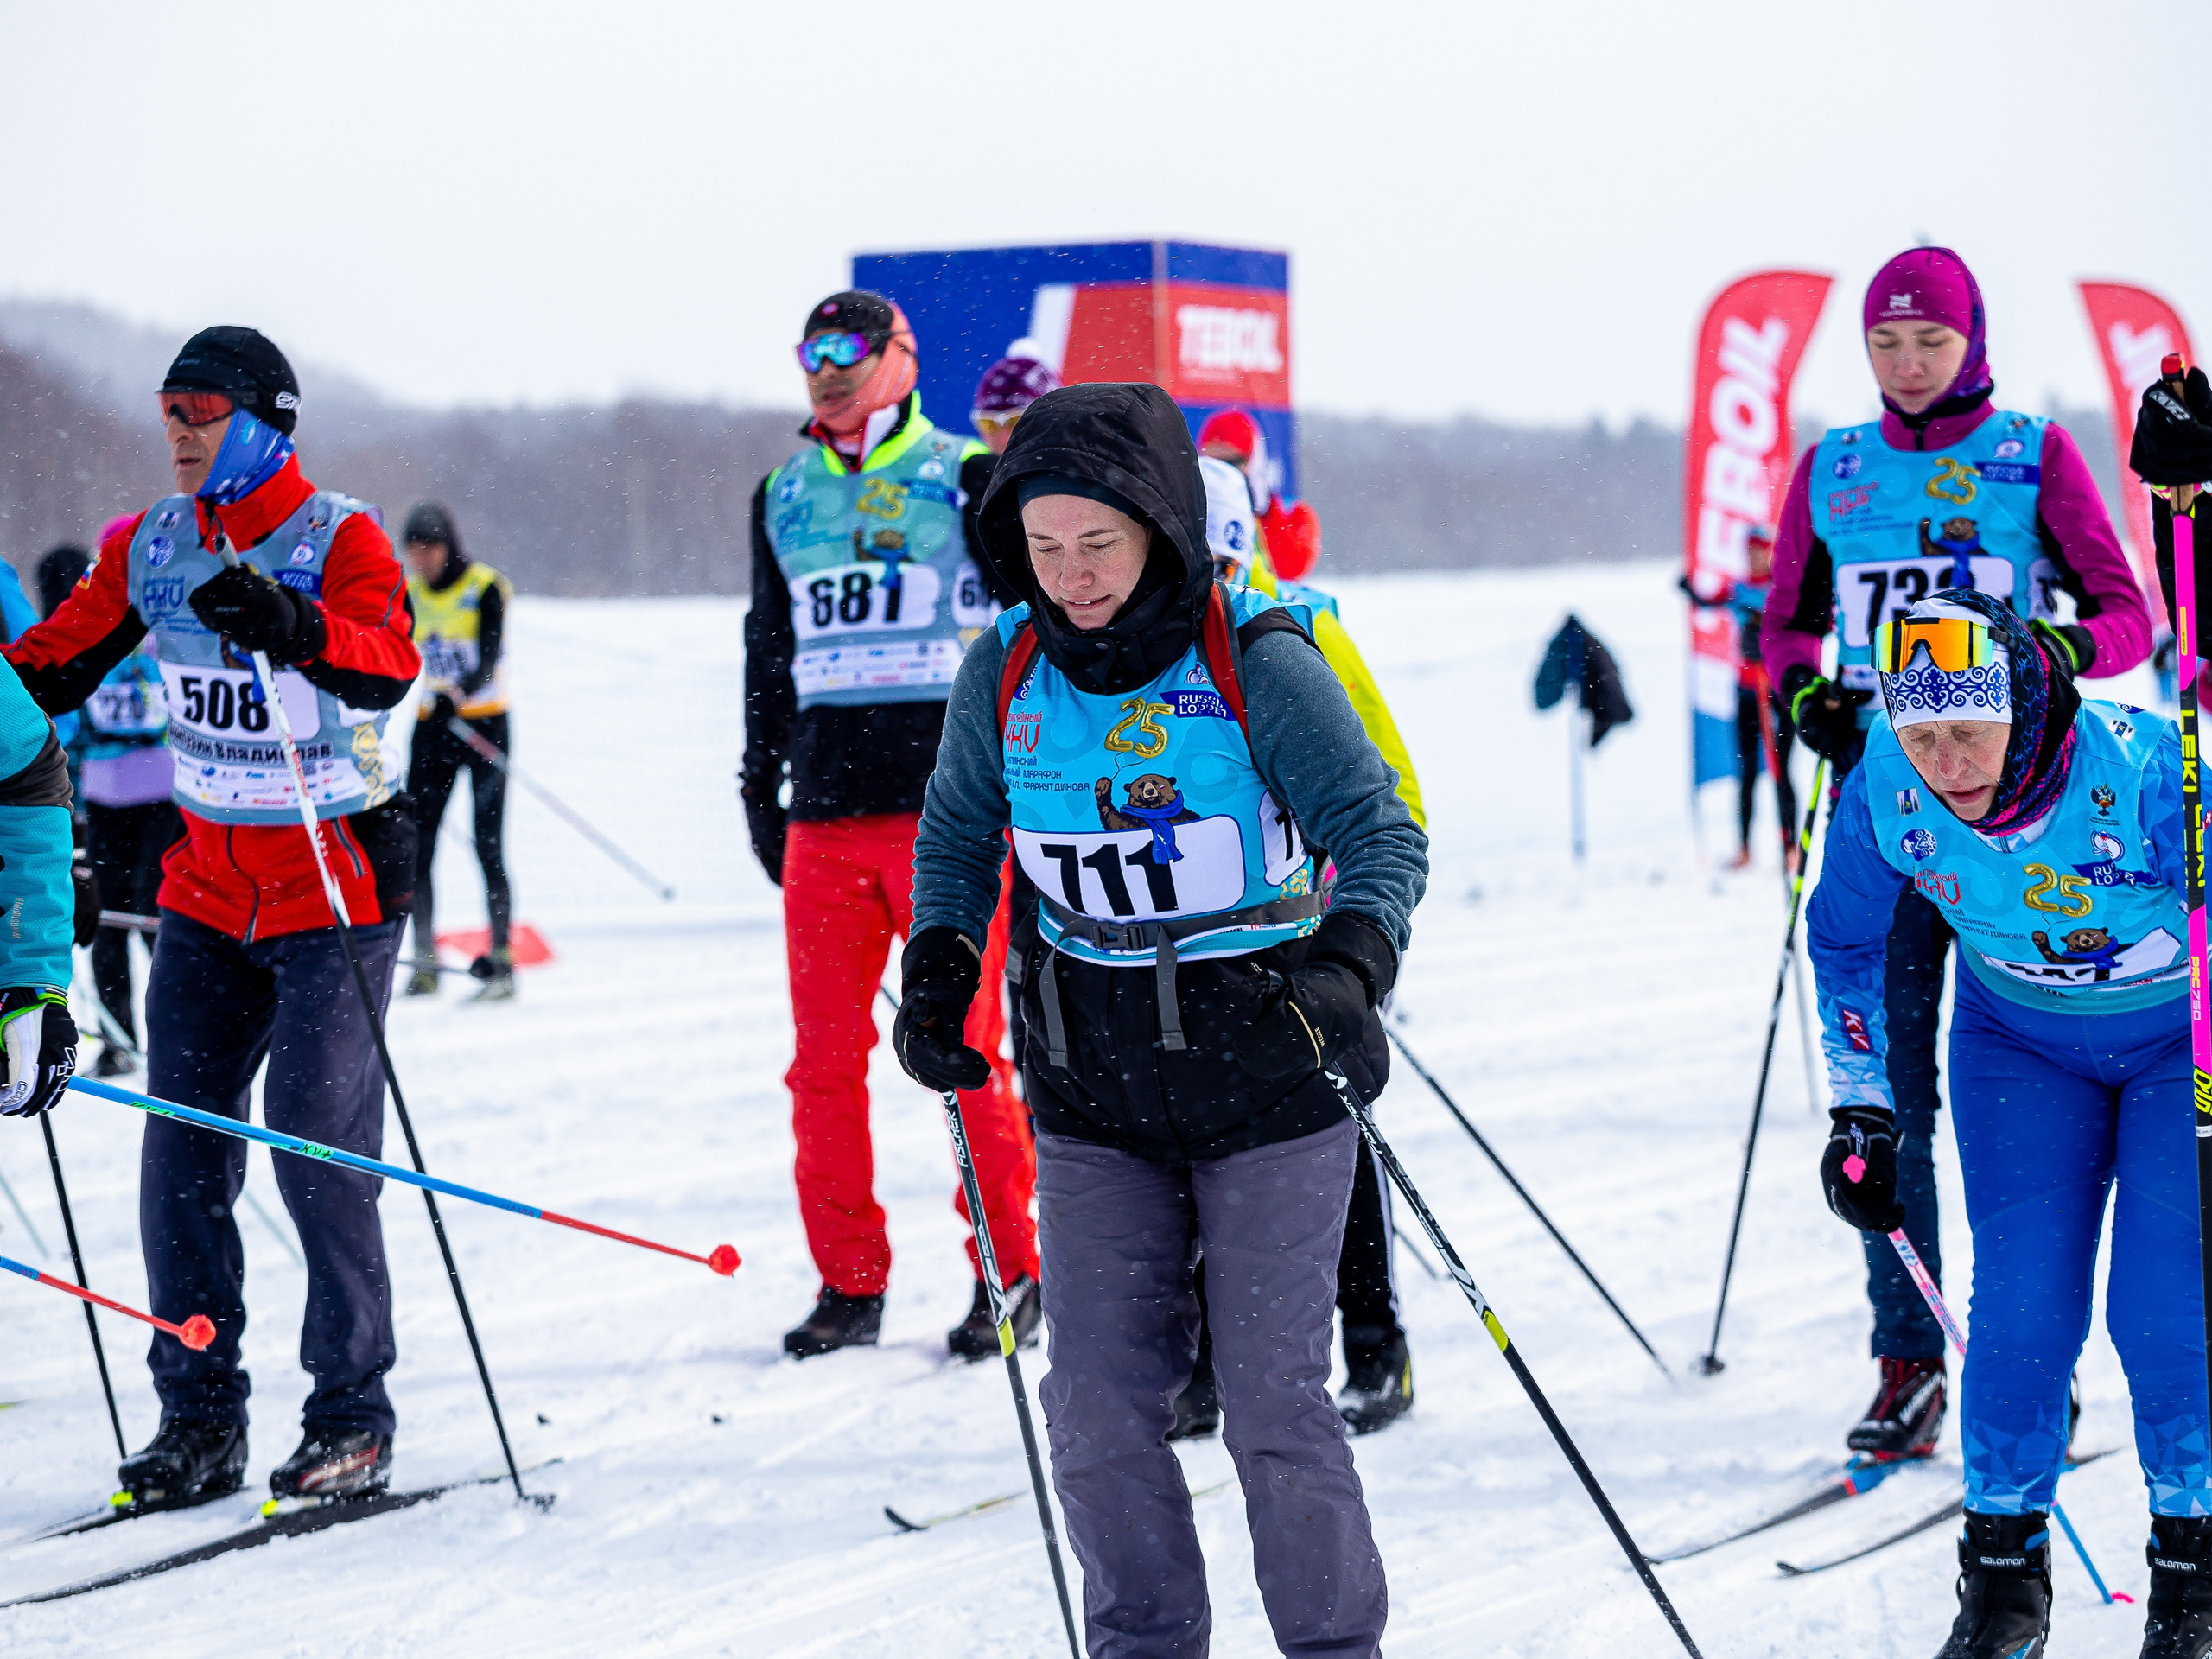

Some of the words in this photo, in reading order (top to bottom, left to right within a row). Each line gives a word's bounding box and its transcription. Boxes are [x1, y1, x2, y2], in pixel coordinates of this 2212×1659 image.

[857, 478, 909, 519] 25
[1926, 456, 1982, 505] 25
[810, 572, 902, 627] 681
[1860, 568, 1974, 636] 73
[181, 674, 270, 732] 508
[1104, 696, 1175, 759] 25
[2181, 709, 2197, 793] LEKI
[1040, 839, 1180, 917] 711
[2023, 862, 2094, 918] 25
[2192, 989, 2202, 1021] 750
[1314, 1027, 1325, 1047] WEDZE
[946, 1110, 969, 1168] FISCHER
